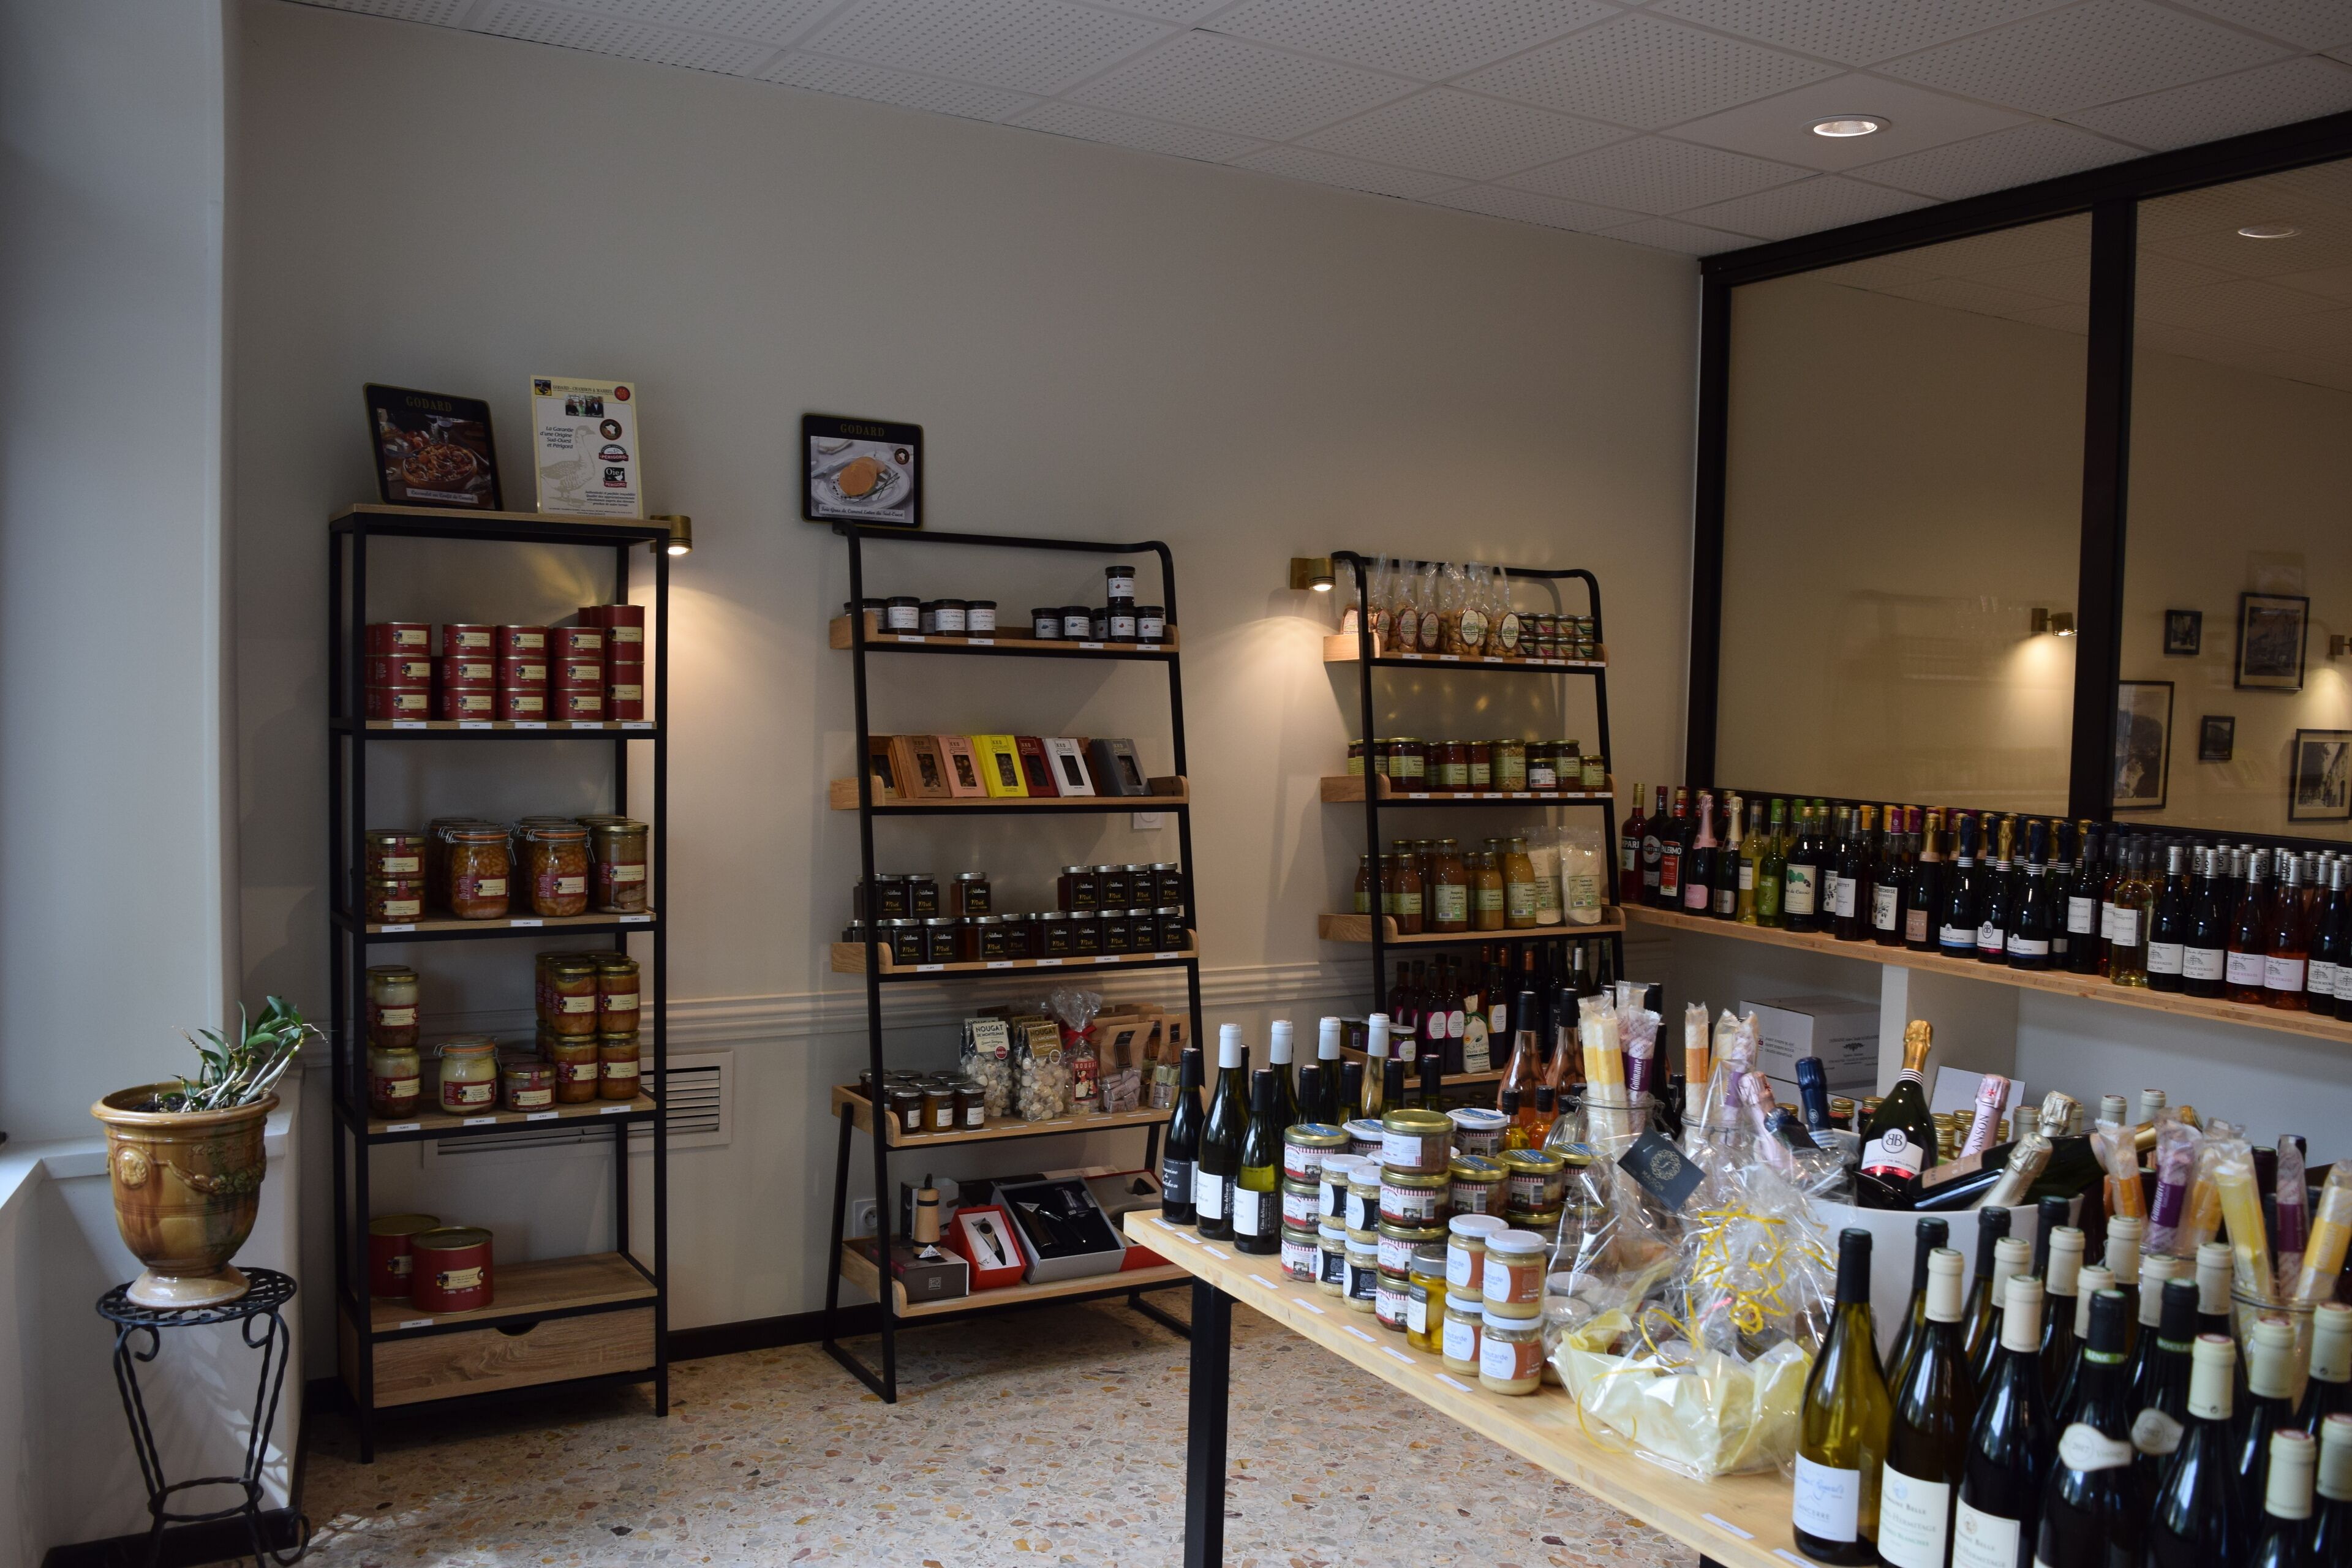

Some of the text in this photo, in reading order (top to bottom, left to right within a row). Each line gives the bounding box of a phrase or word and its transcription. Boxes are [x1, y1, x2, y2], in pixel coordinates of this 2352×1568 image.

[406, 396, 452, 412] GODARD
[840, 423, 884, 437] GODARD
[606, 467, 619, 476] Oie
[1661, 845, 1682, 855] PALERMO
[976, 1024, 1003, 1033] NOUGAT
[1030, 1028, 1056, 1036] NOUGAT
[1630, 1058, 1643, 1090] Guimauve
[1969, 1114, 1990, 1156] ANSON
[1905, 1502, 1927, 1515] BELLE
[1975, 1538, 1995, 1551] BELLE
